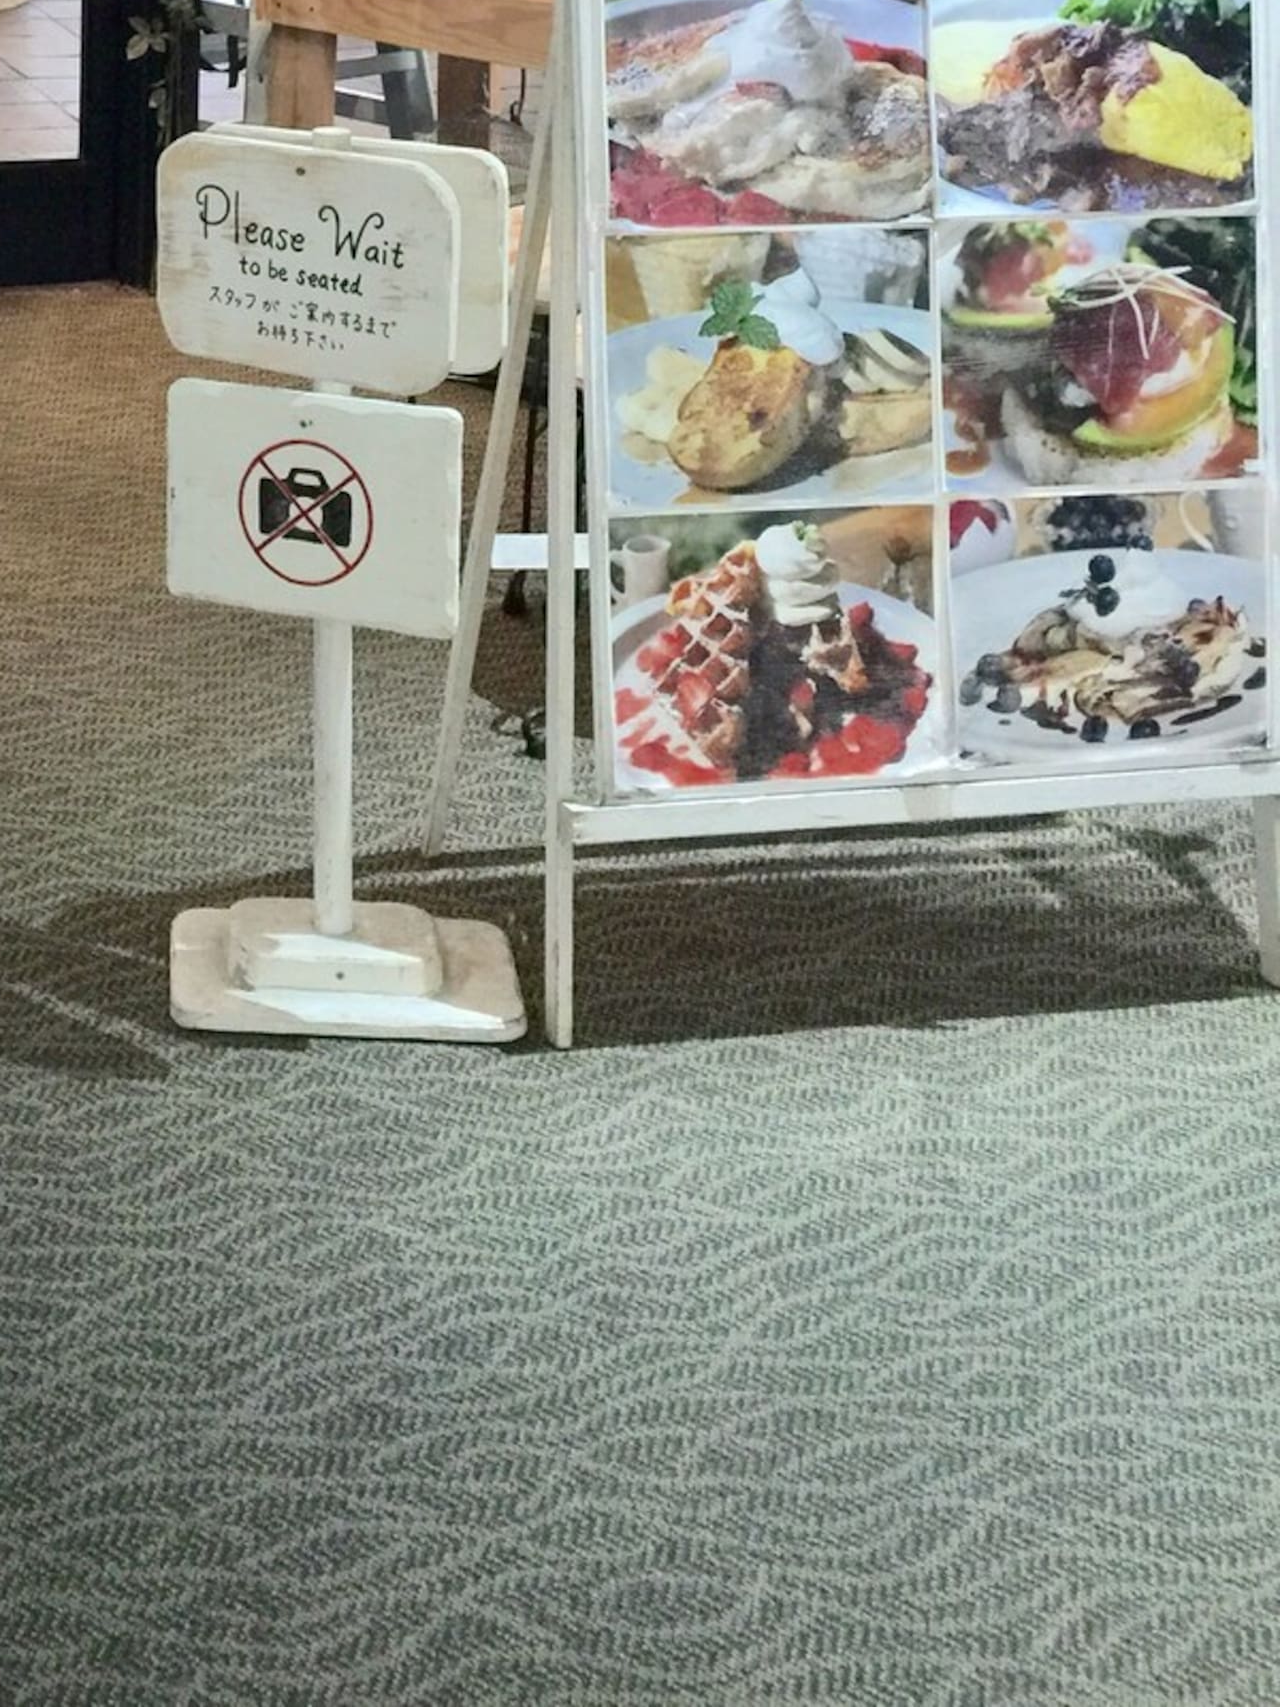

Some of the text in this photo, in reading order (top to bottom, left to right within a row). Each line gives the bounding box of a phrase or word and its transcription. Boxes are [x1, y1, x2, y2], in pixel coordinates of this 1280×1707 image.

[196, 184, 405, 269] Please Wait
[239, 255, 364, 297] to be seated
